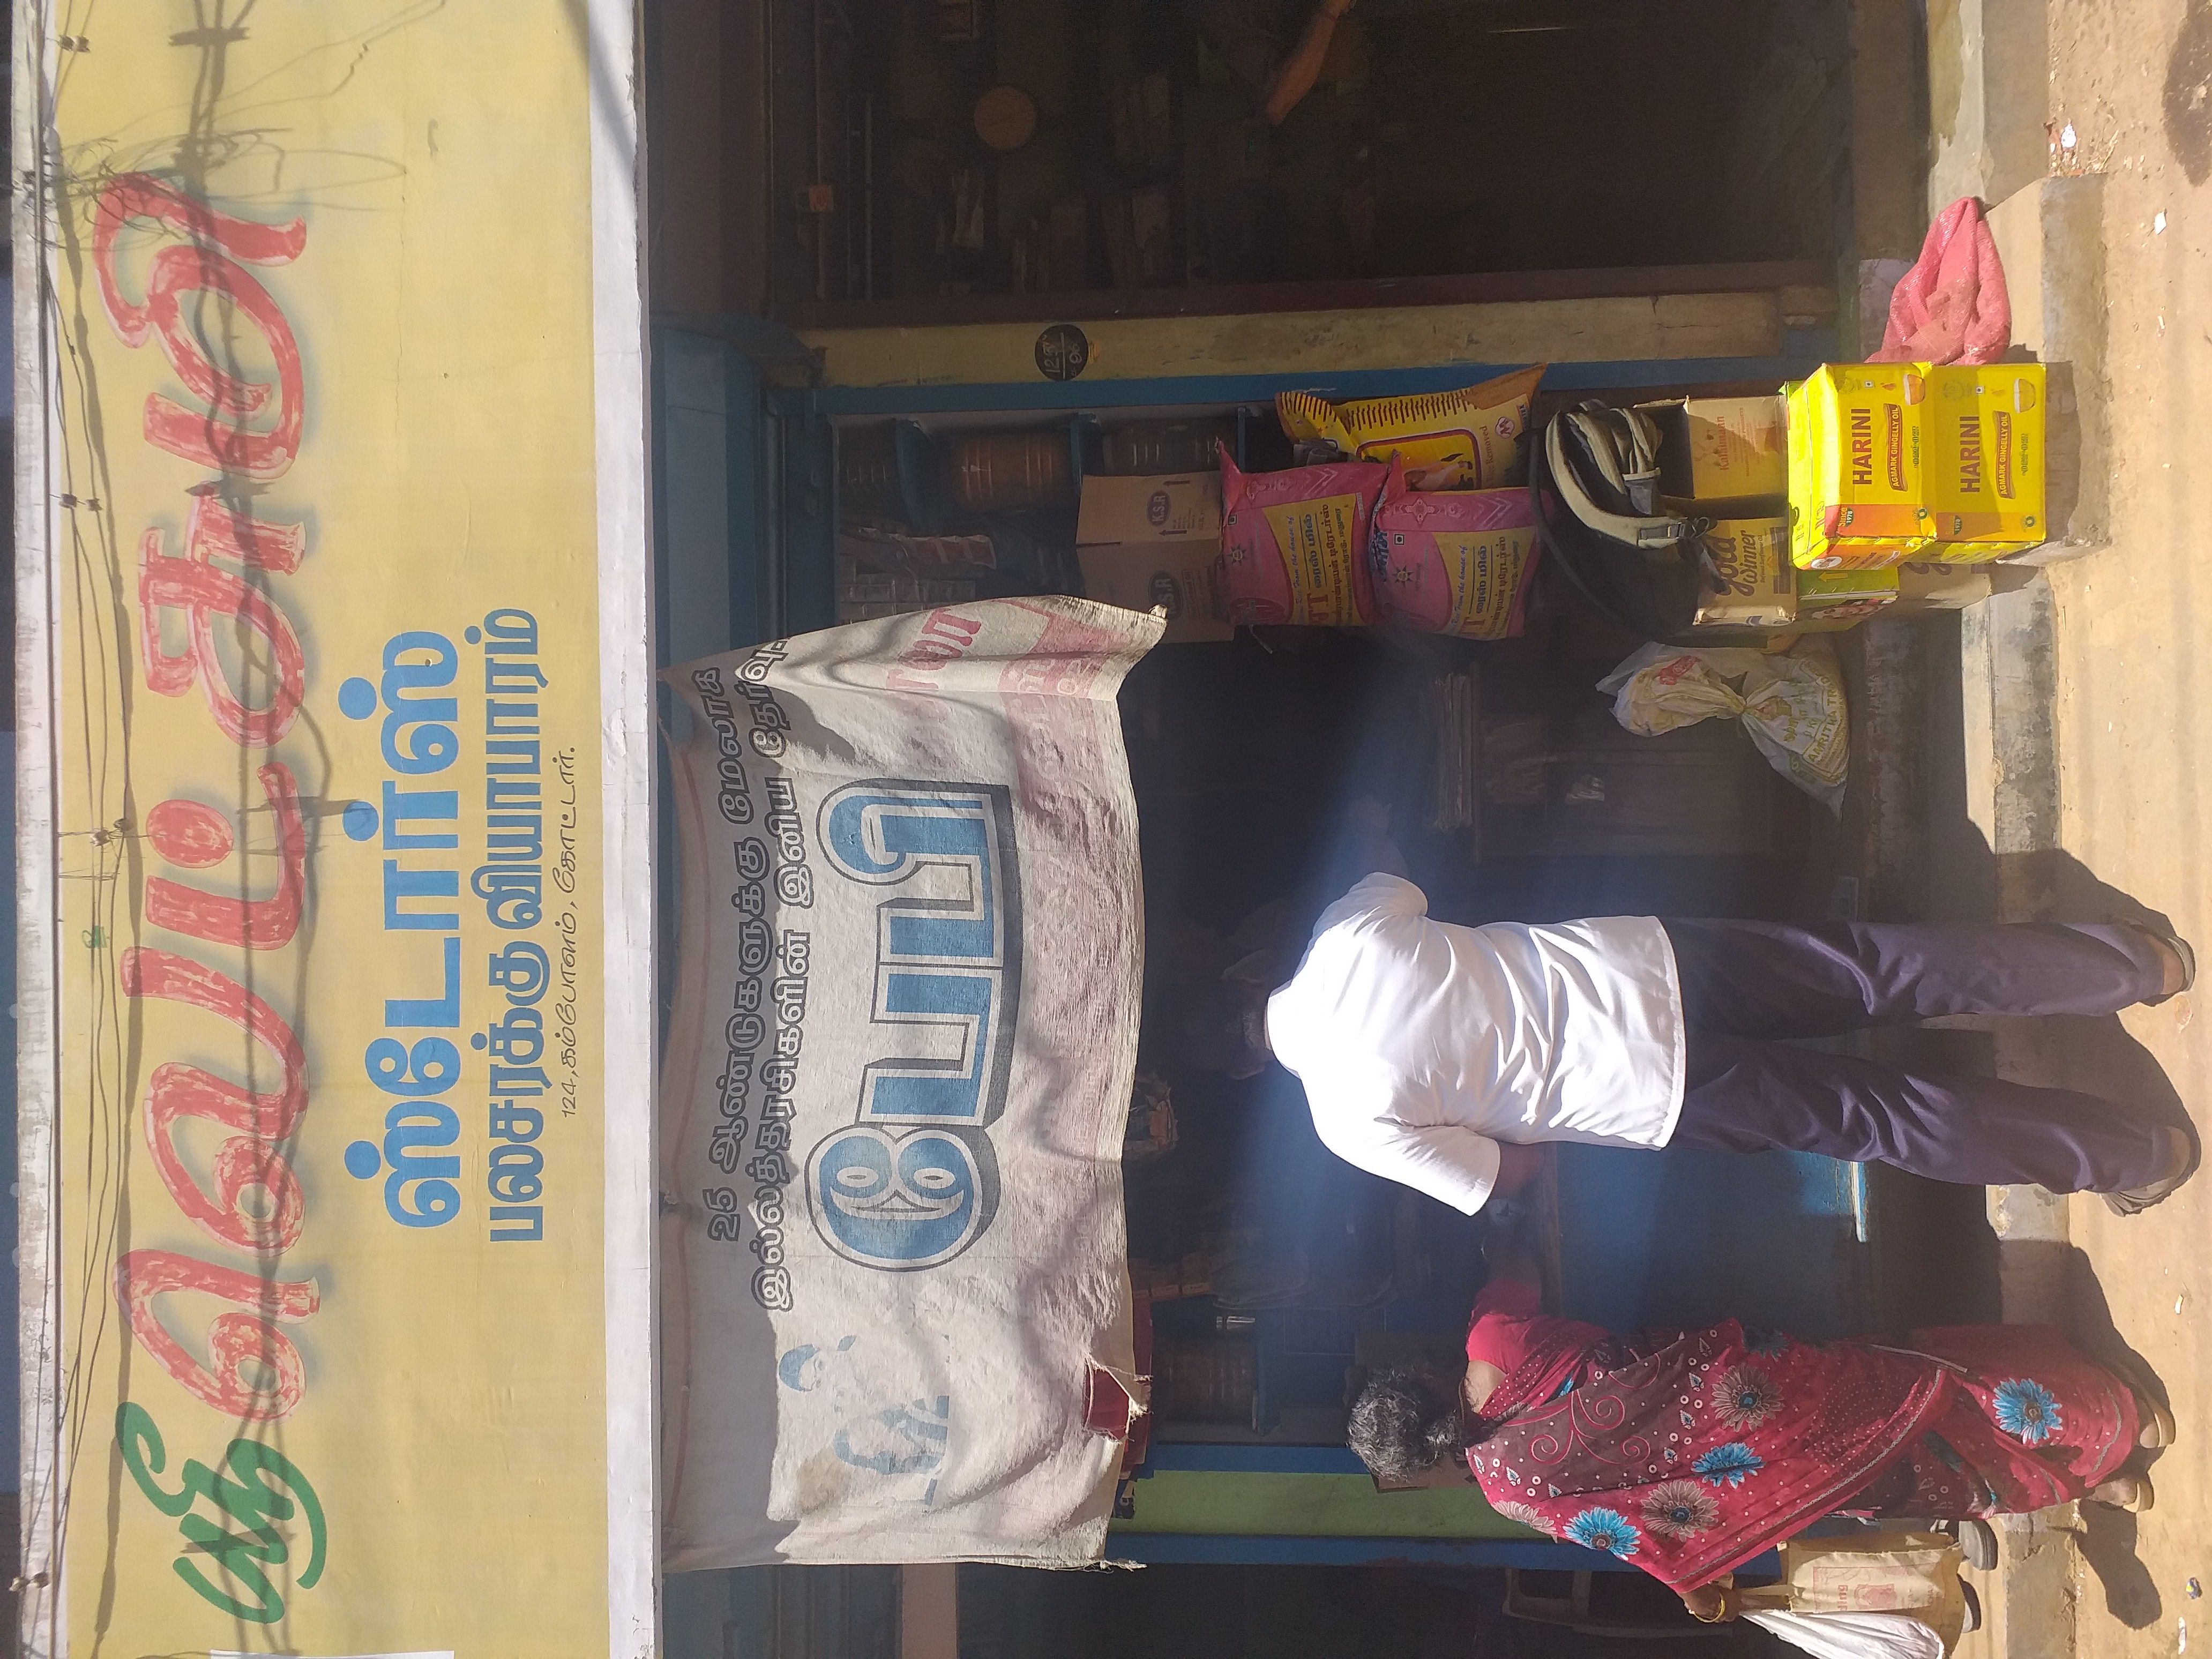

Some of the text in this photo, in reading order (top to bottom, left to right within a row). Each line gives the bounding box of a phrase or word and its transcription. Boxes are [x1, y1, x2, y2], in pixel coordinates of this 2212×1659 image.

[1479, 425, 1493, 464] Removed
[1850, 408, 1872, 485] HARINI
[1890, 407, 1900, 487] AGMARK GINGELLY OIL
[1959, 416, 1980, 493] HARINI
[1998, 414, 2008, 495] AGMARK GINGELLY OIL
[1287, 515, 1295, 525] of
[1288, 527, 1296, 551] house
[1458, 545, 1468, 555] of
[92, 170, 320, 1424] லெட்சுமி
[764, 778, 814, 909] இனிய
[338, 631, 461, 1228] ஸ்டோர்ஸ்
[464, 608, 553, 1242] பலசரக்கு வியாபாரம்
[691, 667, 773, 1242] 25 ஆண்டுகளுக்கு மேலாக
[804, 779, 1023, 1272] பேபி
[745, 929, 812, 1312] இல்லத்தரசிகளின்
